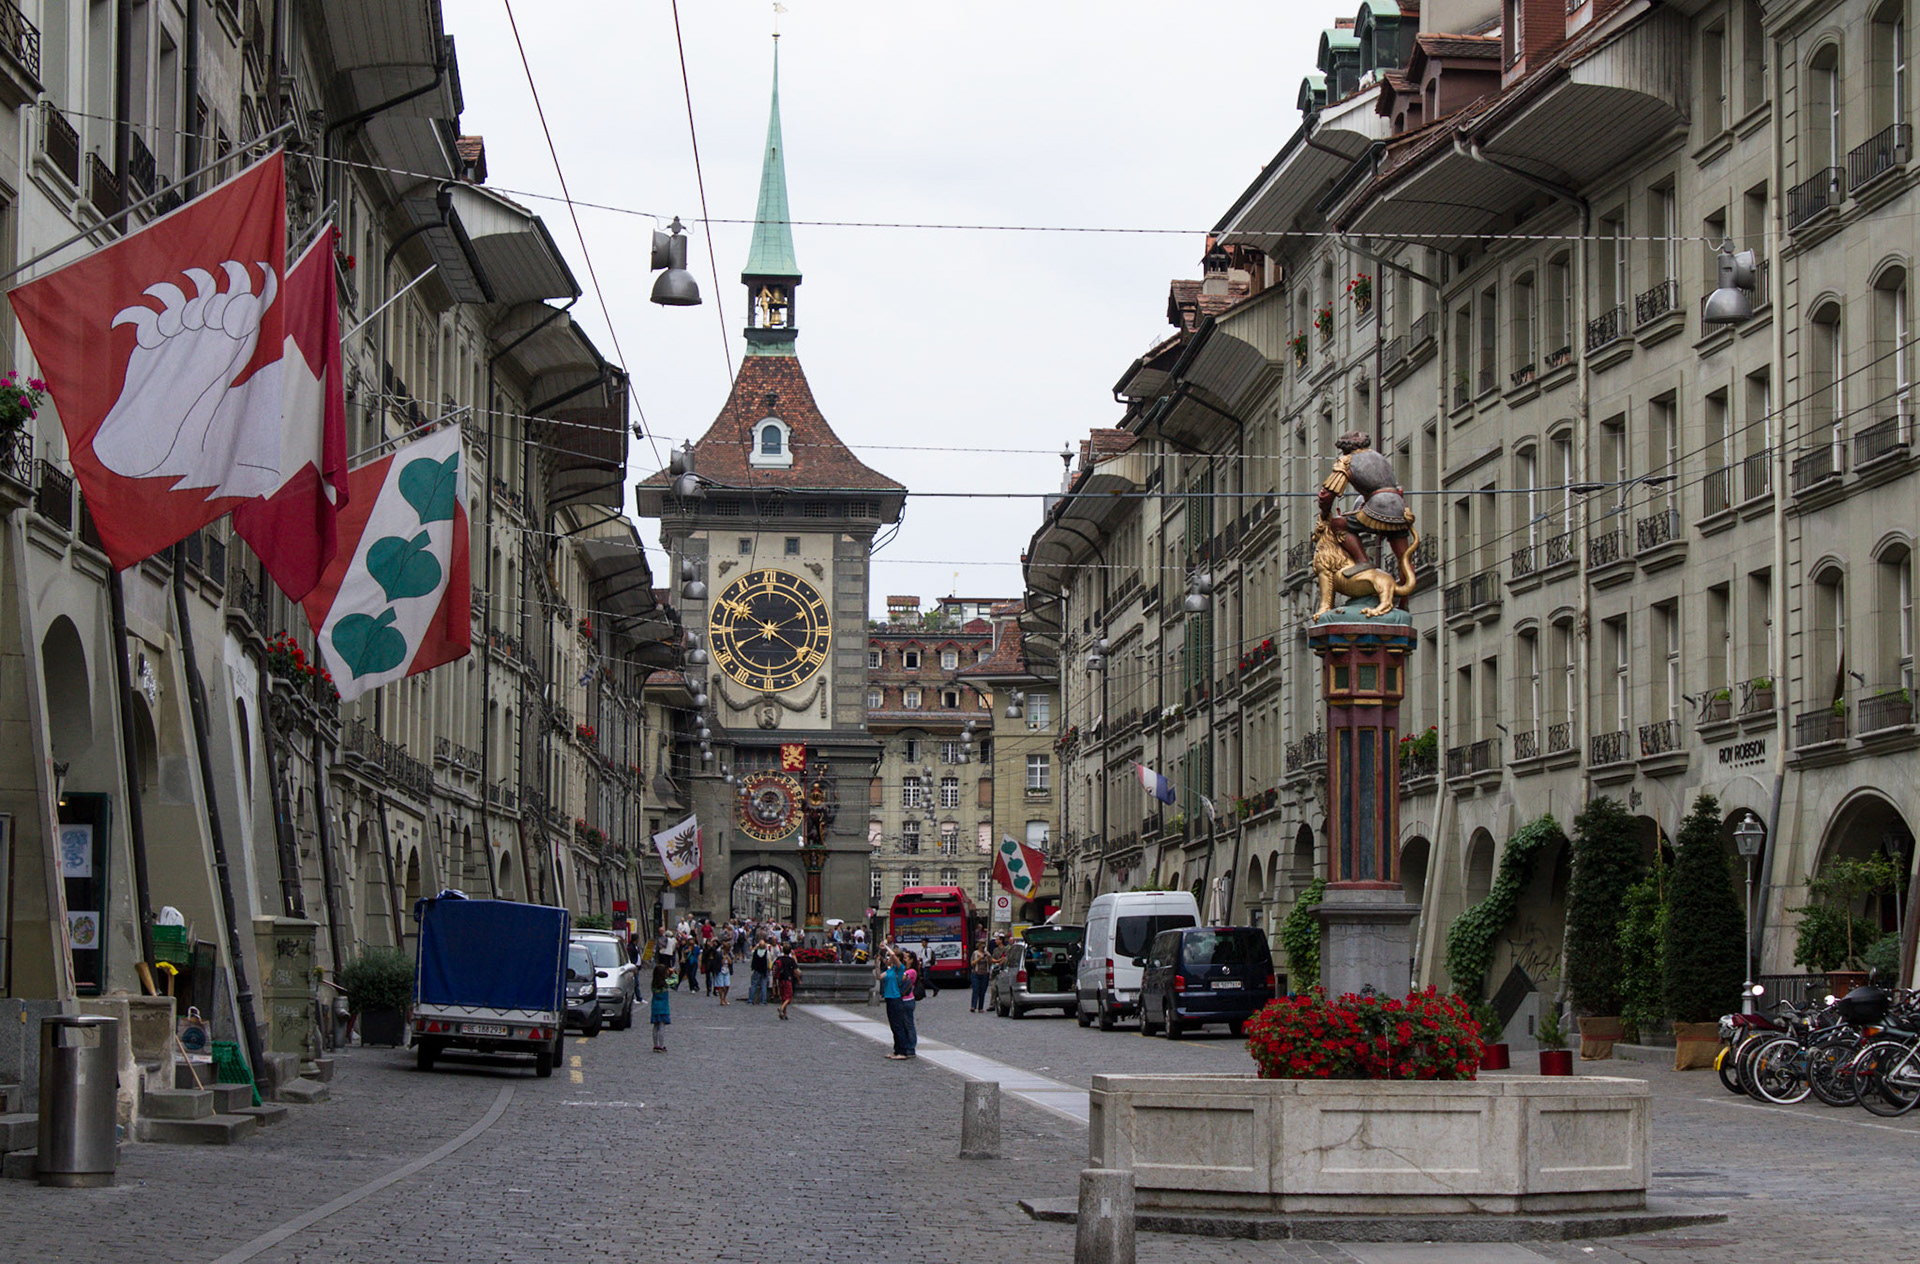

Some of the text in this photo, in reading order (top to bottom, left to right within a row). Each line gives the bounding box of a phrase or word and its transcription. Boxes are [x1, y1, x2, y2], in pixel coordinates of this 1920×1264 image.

[762, 570, 776, 583] XII
[737, 577, 749, 593] XI
[793, 578, 801, 590] I
[810, 598, 823, 609] II
[817, 625, 829, 636] III
[808, 650, 824, 666] IIII
[734, 667, 750, 684] VII
[791, 671, 802, 684] V
[763, 677, 775, 690] VI
[1719, 738, 1766, 765] ROY ROBSON
